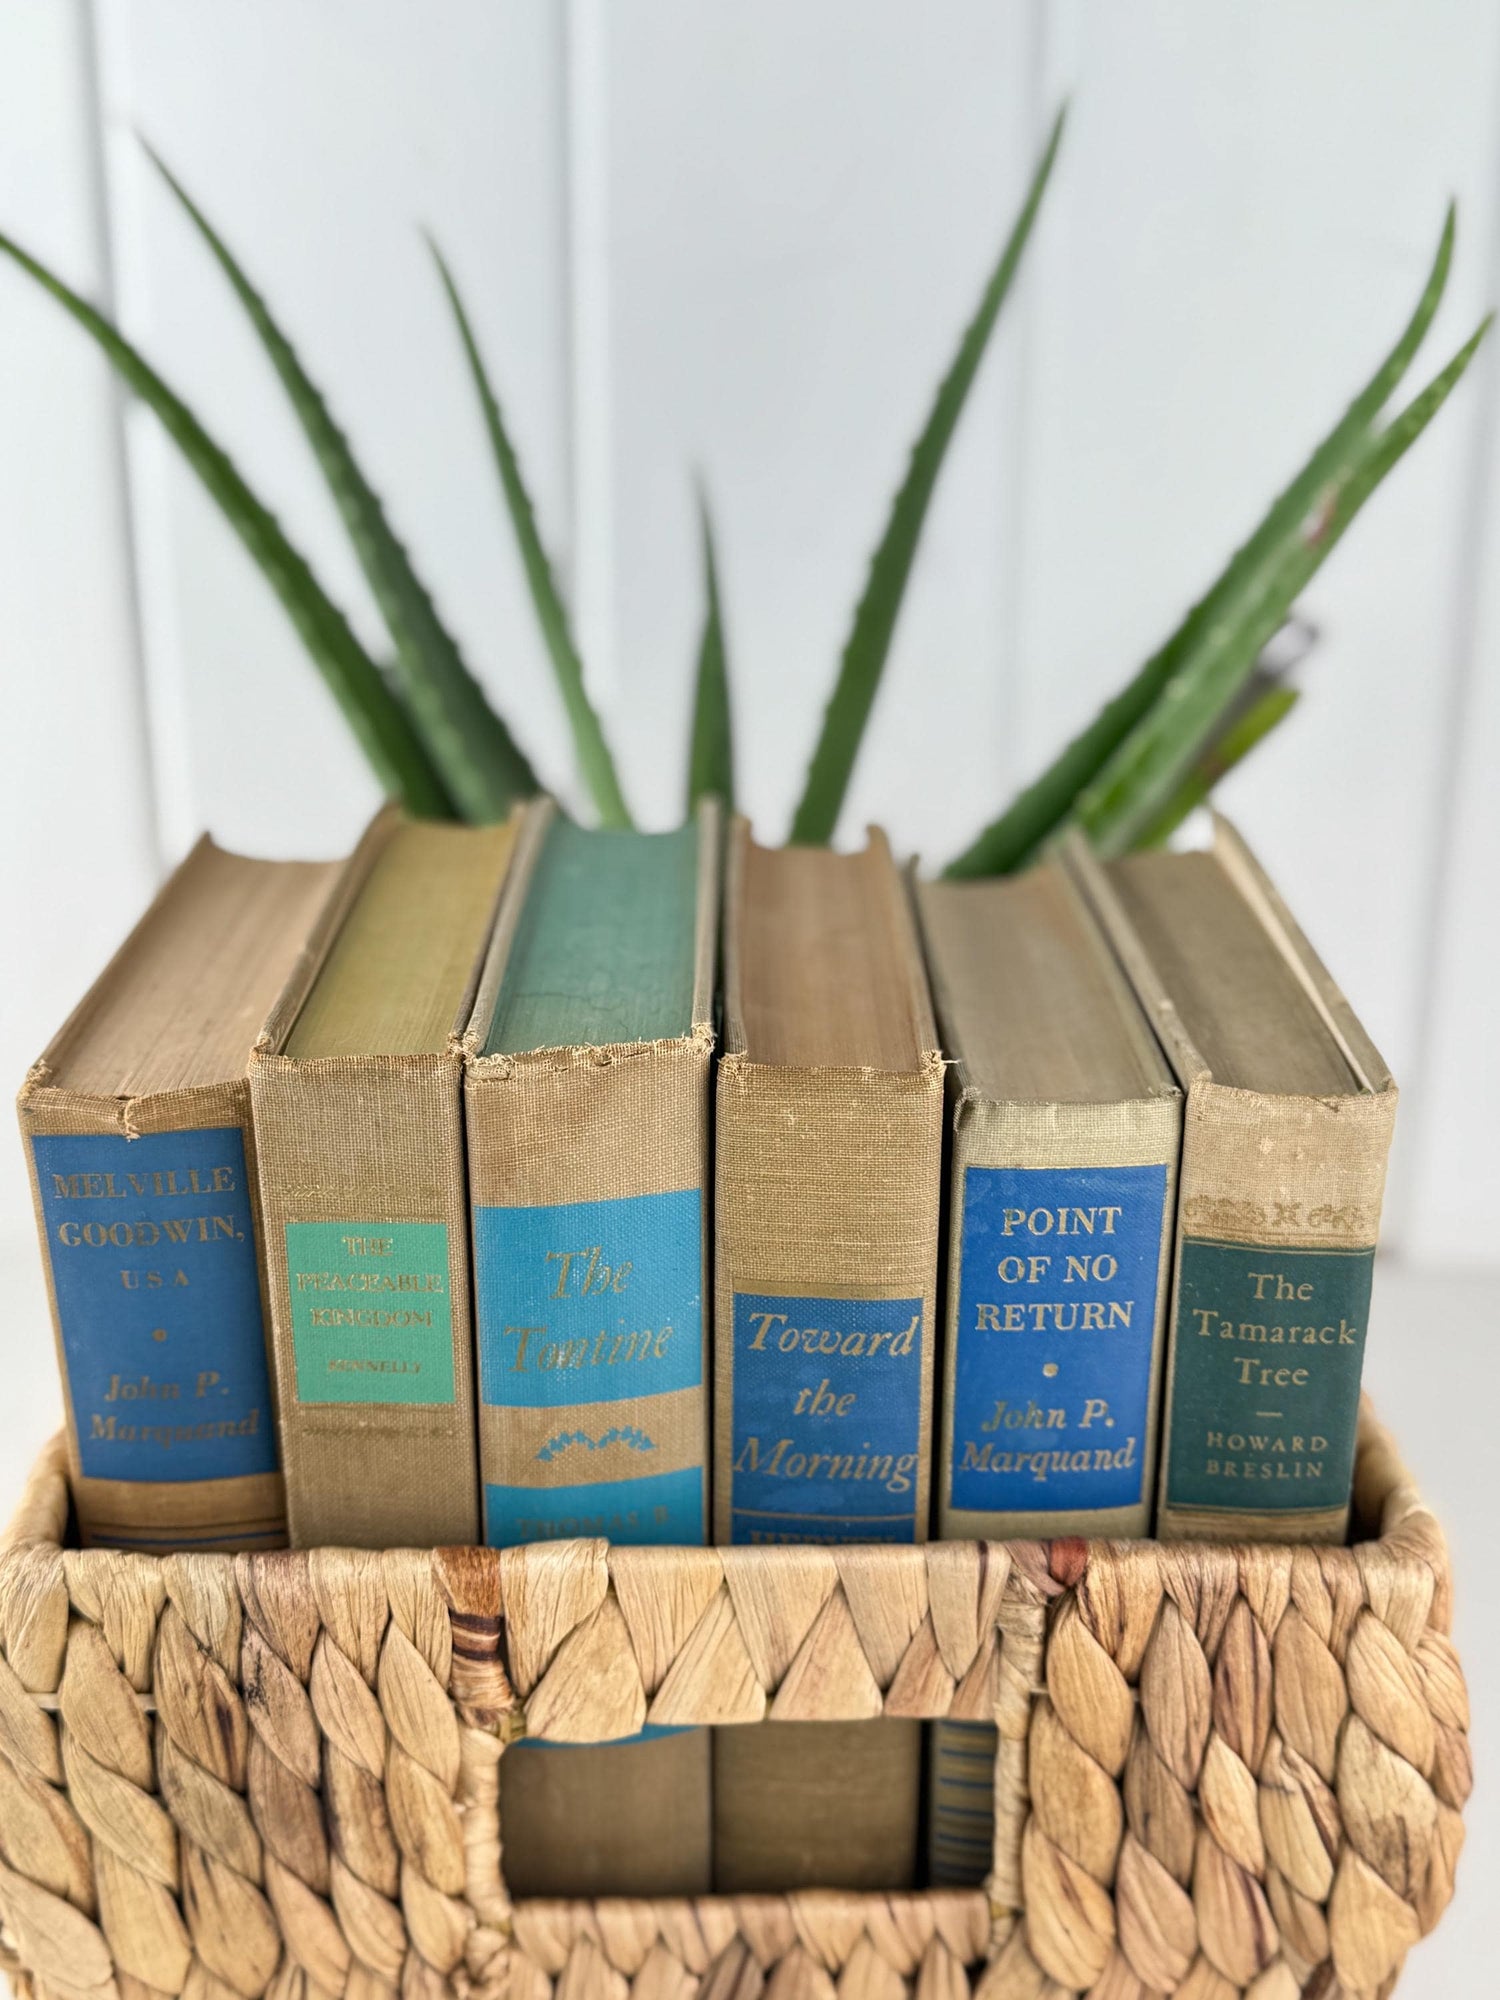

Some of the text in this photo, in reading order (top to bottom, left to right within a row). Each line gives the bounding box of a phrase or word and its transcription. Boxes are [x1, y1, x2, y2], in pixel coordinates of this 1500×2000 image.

[53, 1167, 236, 1199] MELVILLE
[57, 1215, 244, 1247] GOODWIN,
[1001, 1206, 1122, 1236] POINT
[341, 1236, 393, 1256] THE
[296, 1272, 444, 1294] PEACEABLE
[545, 1245, 633, 1299] The
[998, 1254, 1118, 1284] OF NO
[1248, 1273, 1314, 1301] The
[310, 1308, 433, 1328] KINGDOM
[975, 1301, 1135, 1331] RETURN
[1193, 1309, 1356, 1345] Tamarack
[504, 1317, 674, 1373] Tontine
[748, 1312, 919, 1358] Toward
[104, 1371, 230, 1402] John P.
[1234, 1357, 1310, 1387] Tree
[793, 1379, 857, 1417] the
[89, 1408, 261, 1450] Marquand
[981, 1399, 1116, 1432] John P.
[1206, 1431, 1329, 1452] HOWARD
[733, 1437, 919, 1493] Morning
[959, 1437, 1137, 1481] Marquand
[1206, 1459, 1324, 1479] BRESLIN
